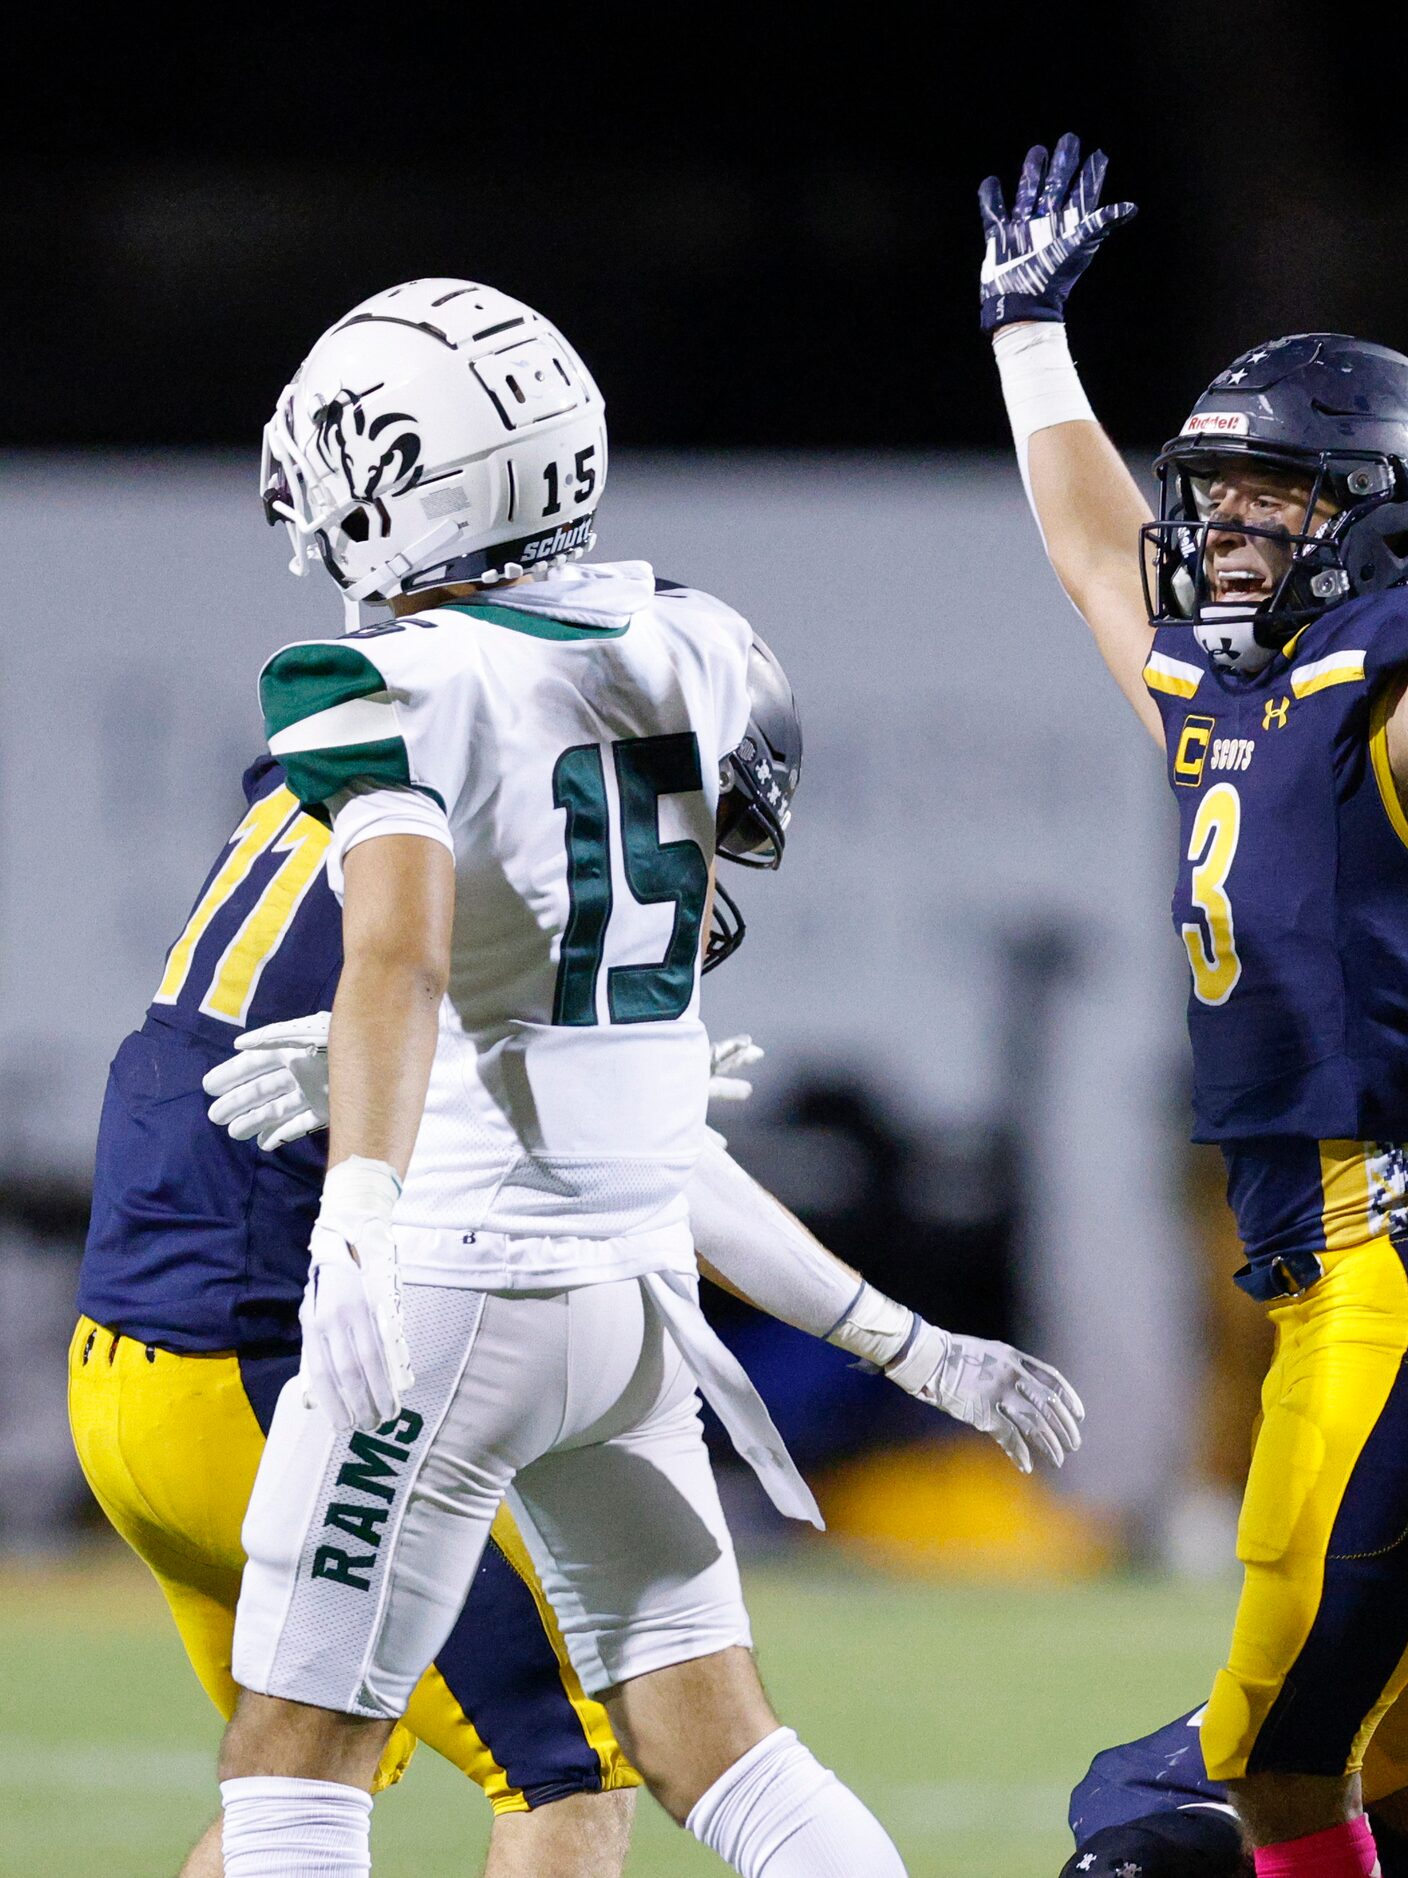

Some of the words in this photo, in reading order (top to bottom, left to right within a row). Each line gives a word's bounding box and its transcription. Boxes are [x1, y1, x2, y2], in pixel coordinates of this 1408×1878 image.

[519, 520, 593, 562] schutt
[542, 445, 597, 517] 15
[1174, 726, 1210, 775] C
[1210, 738, 1255, 771] SCOTS
[152, 782, 335, 1028] 11
[551, 731, 708, 1026] 15
[1182, 782, 1242, 1006] 3
[311, 1407, 424, 1592] RAMS
